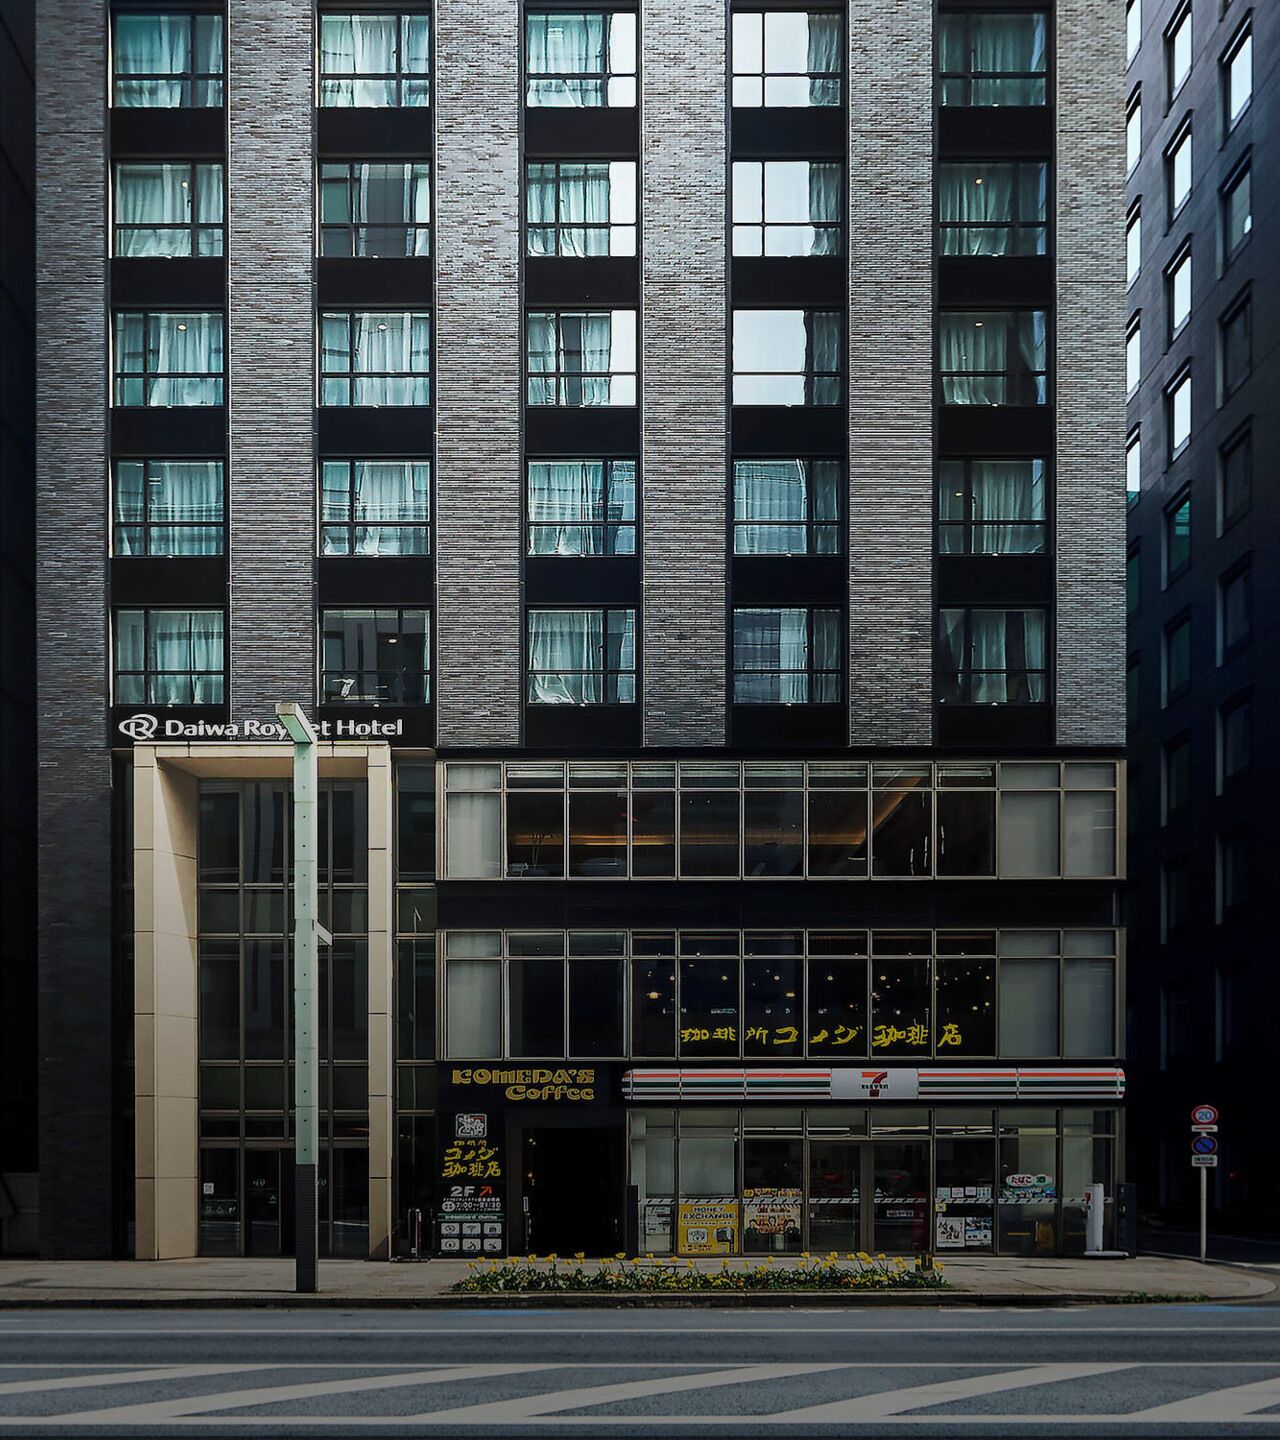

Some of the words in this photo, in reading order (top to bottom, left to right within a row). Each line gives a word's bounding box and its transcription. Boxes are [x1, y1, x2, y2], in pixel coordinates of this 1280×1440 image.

[165, 719, 239, 737] Daiwa
[244, 719, 331, 741] Royet
[337, 719, 403, 737] Hotel
[505, 1085, 595, 1101] Coffee
[1198, 1111, 1212, 1120] 20
[1011, 1175, 1033, 1184] たばこ
[450, 1185, 476, 1197] 2F
